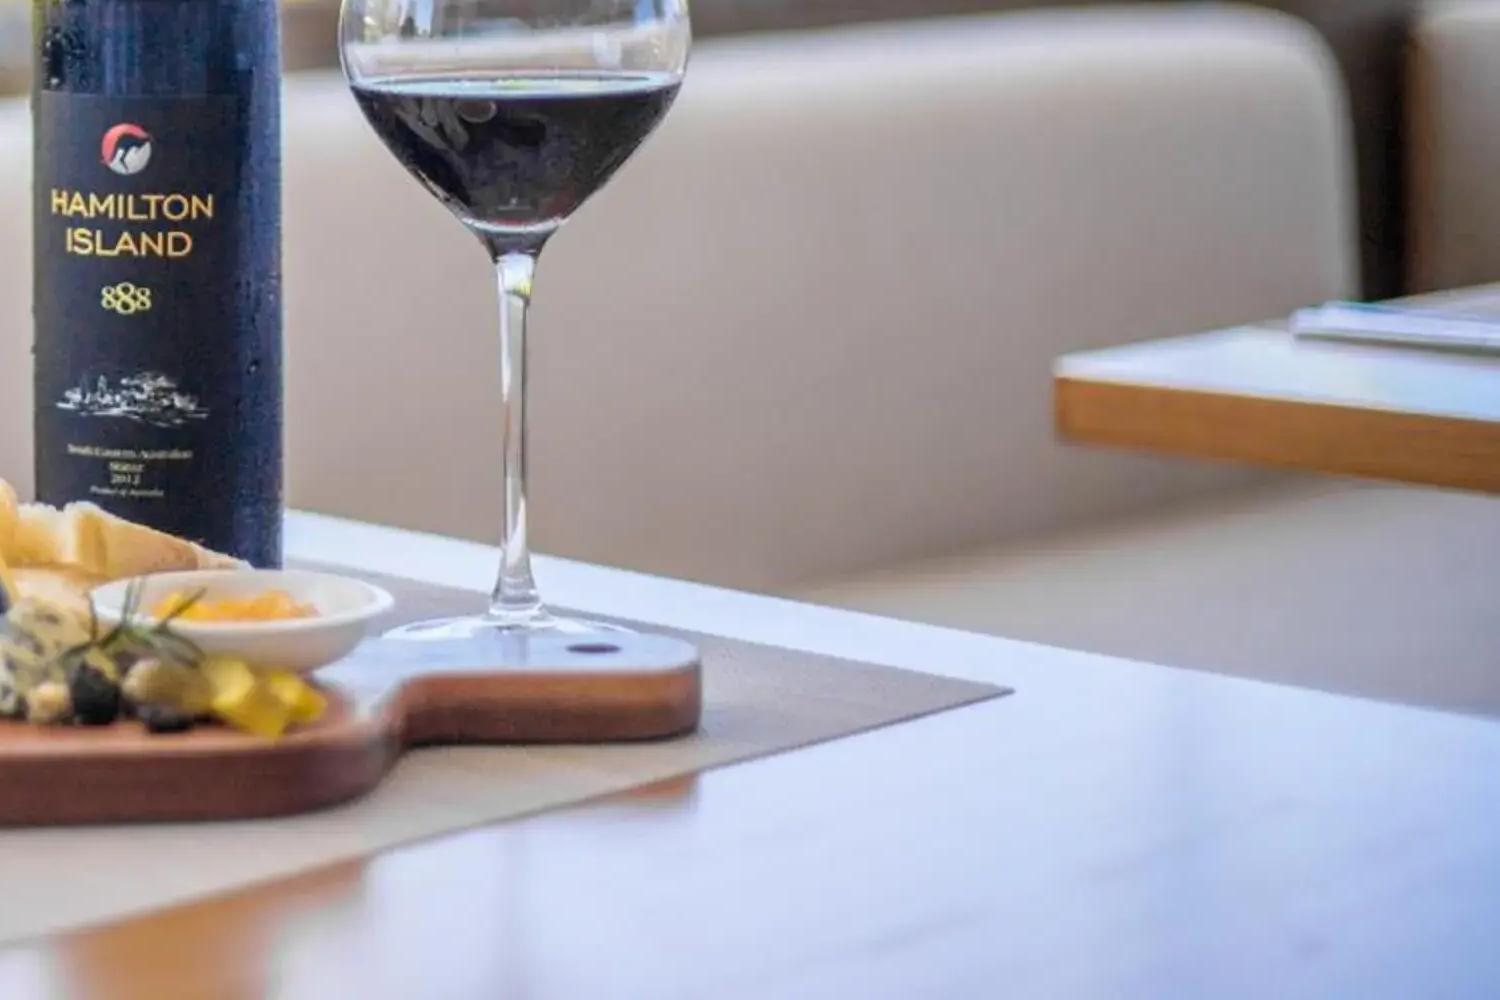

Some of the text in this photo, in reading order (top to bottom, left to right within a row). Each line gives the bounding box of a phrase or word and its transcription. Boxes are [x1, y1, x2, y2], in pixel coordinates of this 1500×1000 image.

[50, 188, 214, 221] HAMILTON
[65, 227, 193, 257] ISLAND
[100, 281, 152, 315] 888
